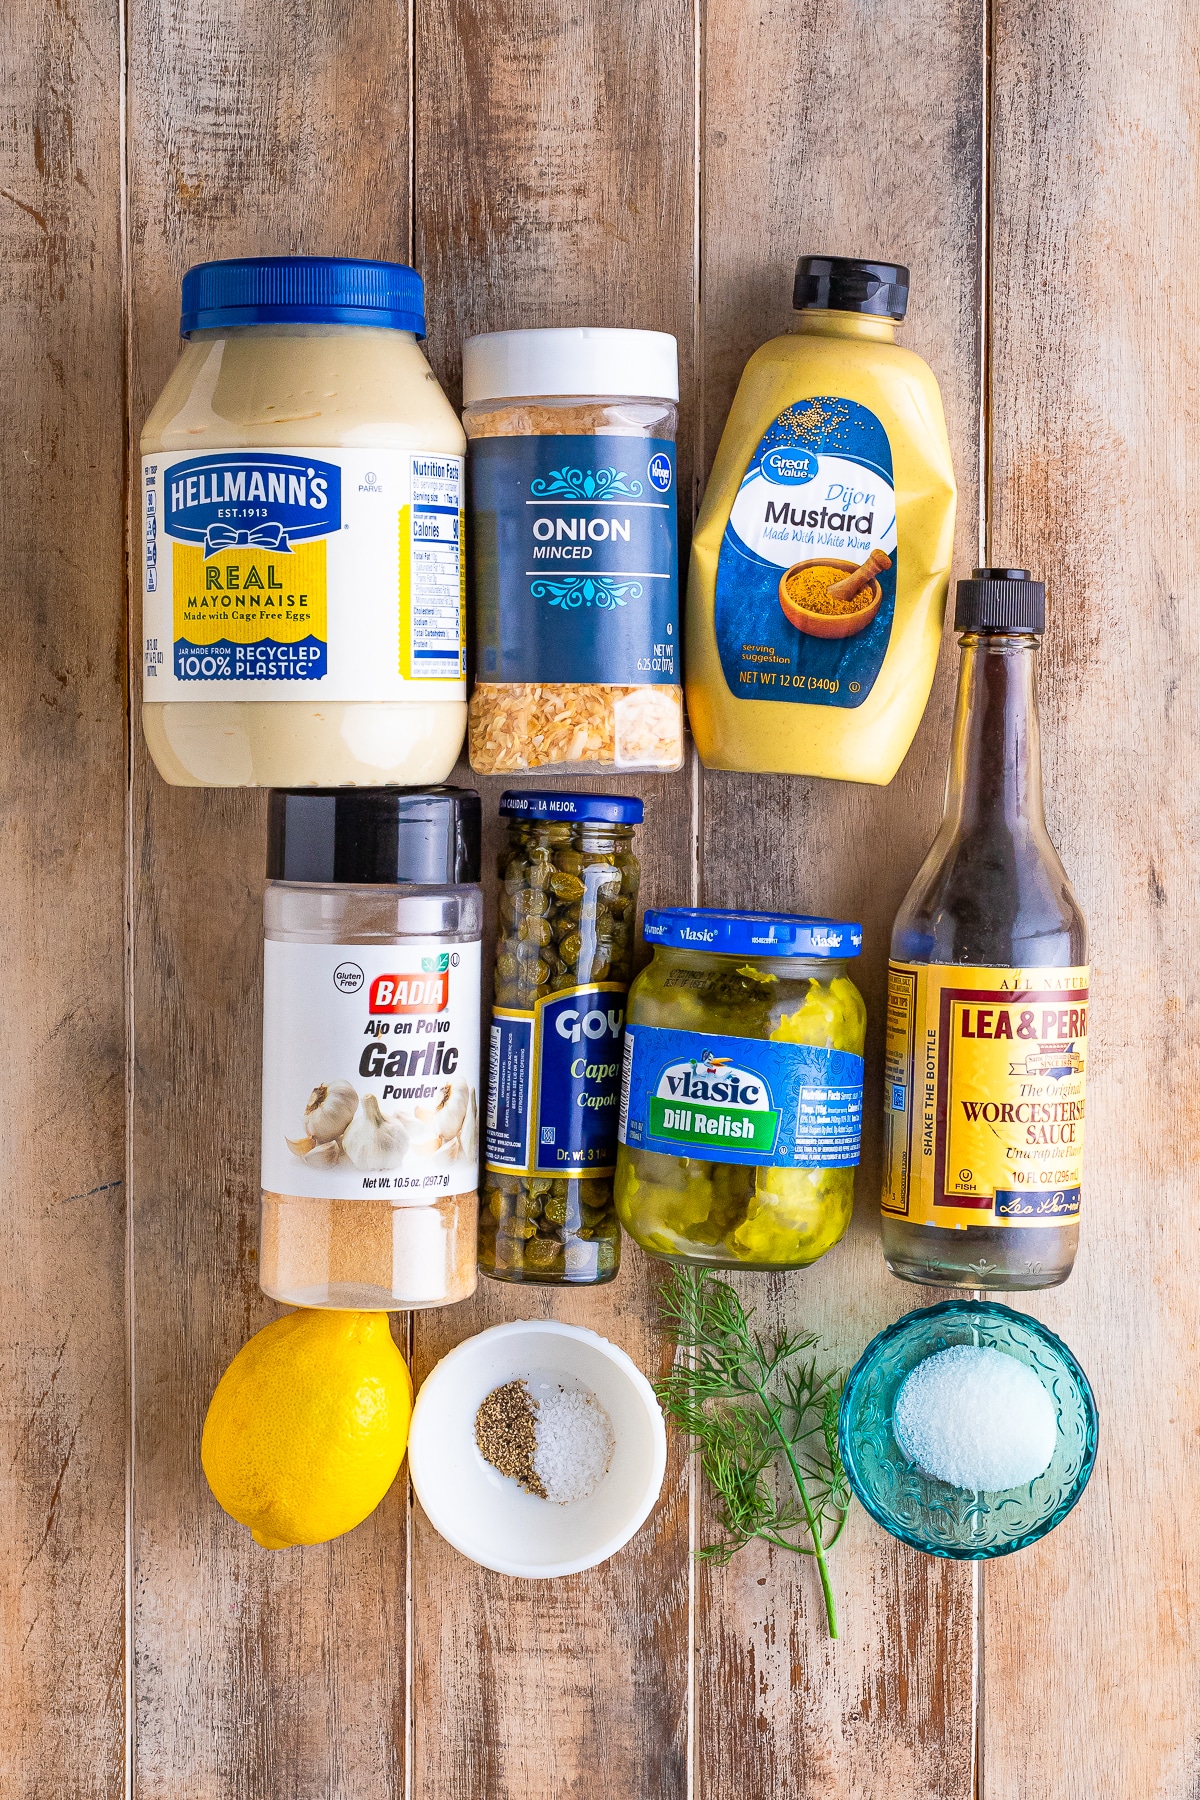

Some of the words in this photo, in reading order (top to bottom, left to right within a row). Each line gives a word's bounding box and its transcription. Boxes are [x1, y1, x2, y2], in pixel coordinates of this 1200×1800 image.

[413, 460, 445, 478] Nutrition
[446, 463, 459, 480] Facts
[770, 454, 810, 471] Great
[652, 459, 670, 486] Kroger
[171, 467, 328, 512] HELLMANN'S
[358, 484, 383, 493] PARVE
[413, 491, 430, 504] Serving
[824, 484, 876, 512] Dijon
[218, 508, 268, 518] EST.1913
[764, 501, 874, 535] Mustard
[414, 520, 440, 538] Calories
[532, 518, 631, 542] ONION
[762, 527, 790, 542] Made
[792, 529, 814, 544] With
[816, 532, 844, 548] White
[846, 536, 871, 550] Wine
[533, 546, 593, 559] MINCED
[205, 565, 283, 590] REAL
[188, 594, 308, 608] MAYONNAISE
[183, 611, 206, 621] Made
[208, 610, 229, 620] with
[231, 611, 257, 622] Cage
[260, 610, 282, 620] Free
[286, 610, 311, 621] Eggs
[178, 648, 189, 656] JAR
[190, 648, 208, 656] MADE
[209, 648, 231, 656] FROM
[236, 647, 320, 660] RECYCLED
[654, 644, 666, 657] NET
[666, 645, 674, 657] WT
[742, 644, 775, 656] serving
[178, 657, 232, 676] 100%
[637, 658, 652, 671] 6.25
[652, 658, 661, 672] OZ
[742, 652, 790, 666] suggestion
[739, 672, 758, 684] NET
[760, 673, 776, 685] WT
[779, 675, 790, 686] 12
[792, 676, 806, 688] OZ
[808, 678, 840, 693] (340g)
[507, 799, 528, 810] CALIDAD
[538, 800, 548, 810] LA
[550, 801, 577, 812] MEJOR.
[336, 972, 362, 980] Gluten
[340, 980, 358, 988] Free
[1000, 979, 1033, 990] ALL
[375, 979, 444, 1006] BADIA
[364, 1020, 390, 1038] Ajo
[393, 1022, 413, 1034] en
[416, 1018, 450, 1034] Polvo
[961, 1008, 1014, 1040] LEA
[1016, 1009, 1039, 1040] &
[358, 1040, 458, 1078] Garlic
[926, 1029, 937, 1080] BOTTLE
[382, 1084, 438, 1100] Powder
[666, 1071, 760, 1105] vlasic
[925, 1082, 935, 1111] THE
[1020, 1084, 1043, 1097] The
[1046, 1082, 1082, 1100] Original
[662, 1108, 693, 1131] Dill
[694, 1114, 755, 1139] Relish
[923, 1112, 934, 1156] SHAKE
[1026, 1123, 1076, 1144] SAUCE
[556, 1148, 571, 1161] Dr.
[572, 1150, 586, 1160] wt.
[588, 1149, 594, 1160] 3
[1006, 1148, 1050, 1162] Unwrap
[1052, 1146, 1064, 1158] the
[362, 1178, 378, 1189] Net
[378, 1177, 391, 1188] Wt.
[393, 1177, 410, 1188] 10.5
[410, 1179, 422, 1188] oz.
[422, 1174, 442, 1188] (297.7
[442, 1174, 450, 1187] g)
[1012, 1172, 1025, 1184] 10
[1026, 1172, 1038, 1184] FL
[1040, 1171, 1054, 1184] OZ
[954, 1183, 977, 1192] FISH
[1000, 1197, 1034, 1214] Lea
